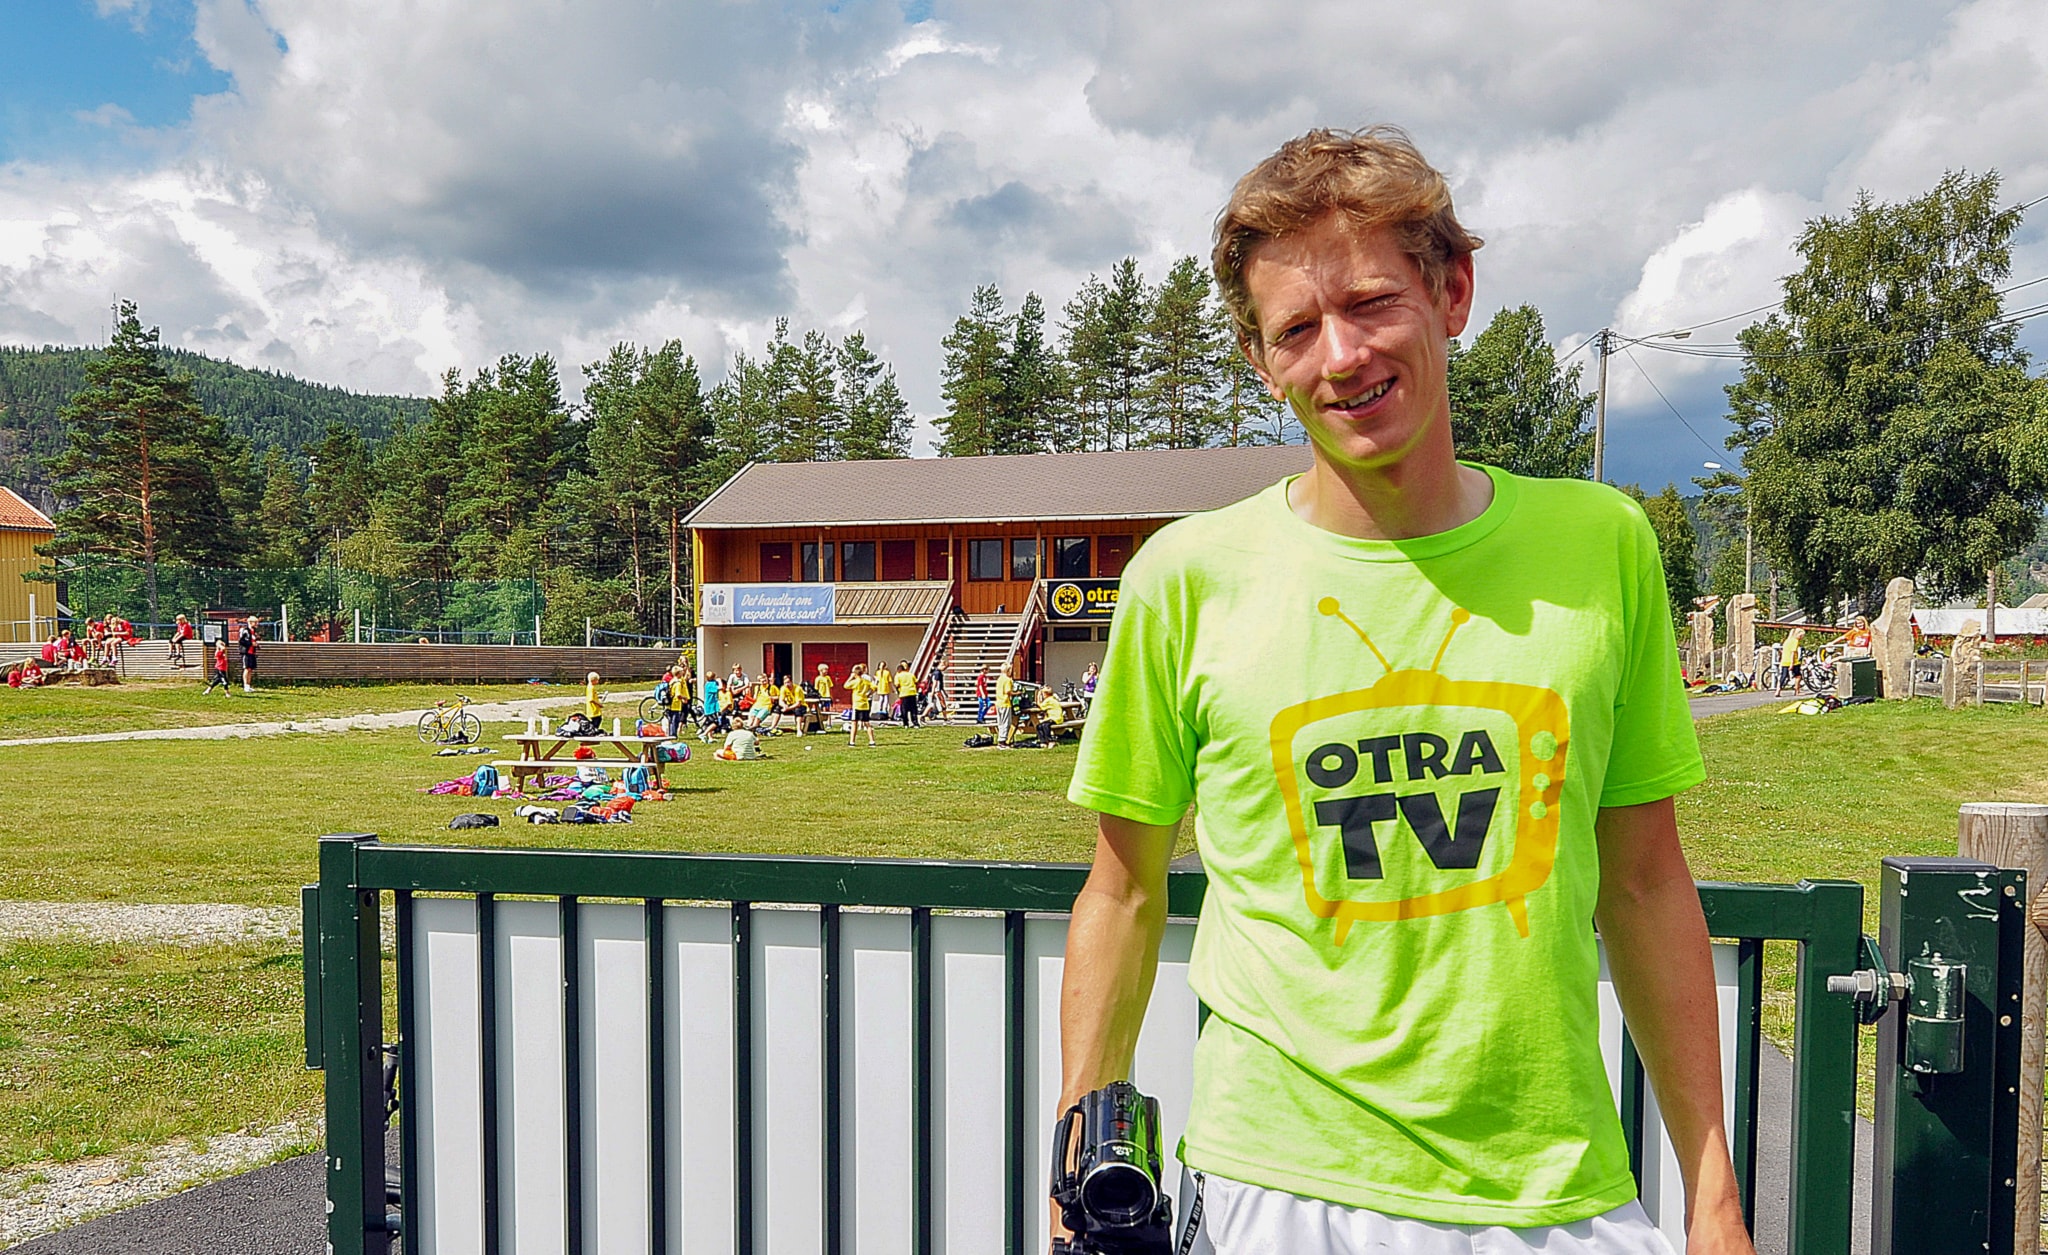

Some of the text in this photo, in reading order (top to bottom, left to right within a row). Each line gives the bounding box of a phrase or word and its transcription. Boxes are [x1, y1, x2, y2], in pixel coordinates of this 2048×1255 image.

[741, 593, 812, 606] Det handler om
[1087, 587, 1119, 602] otra
[741, 607, 826, 623] respekt, ikke sant?
[1306, 730, 1506, 788] OTRA
[1314, 787, 1501, 879] TV
